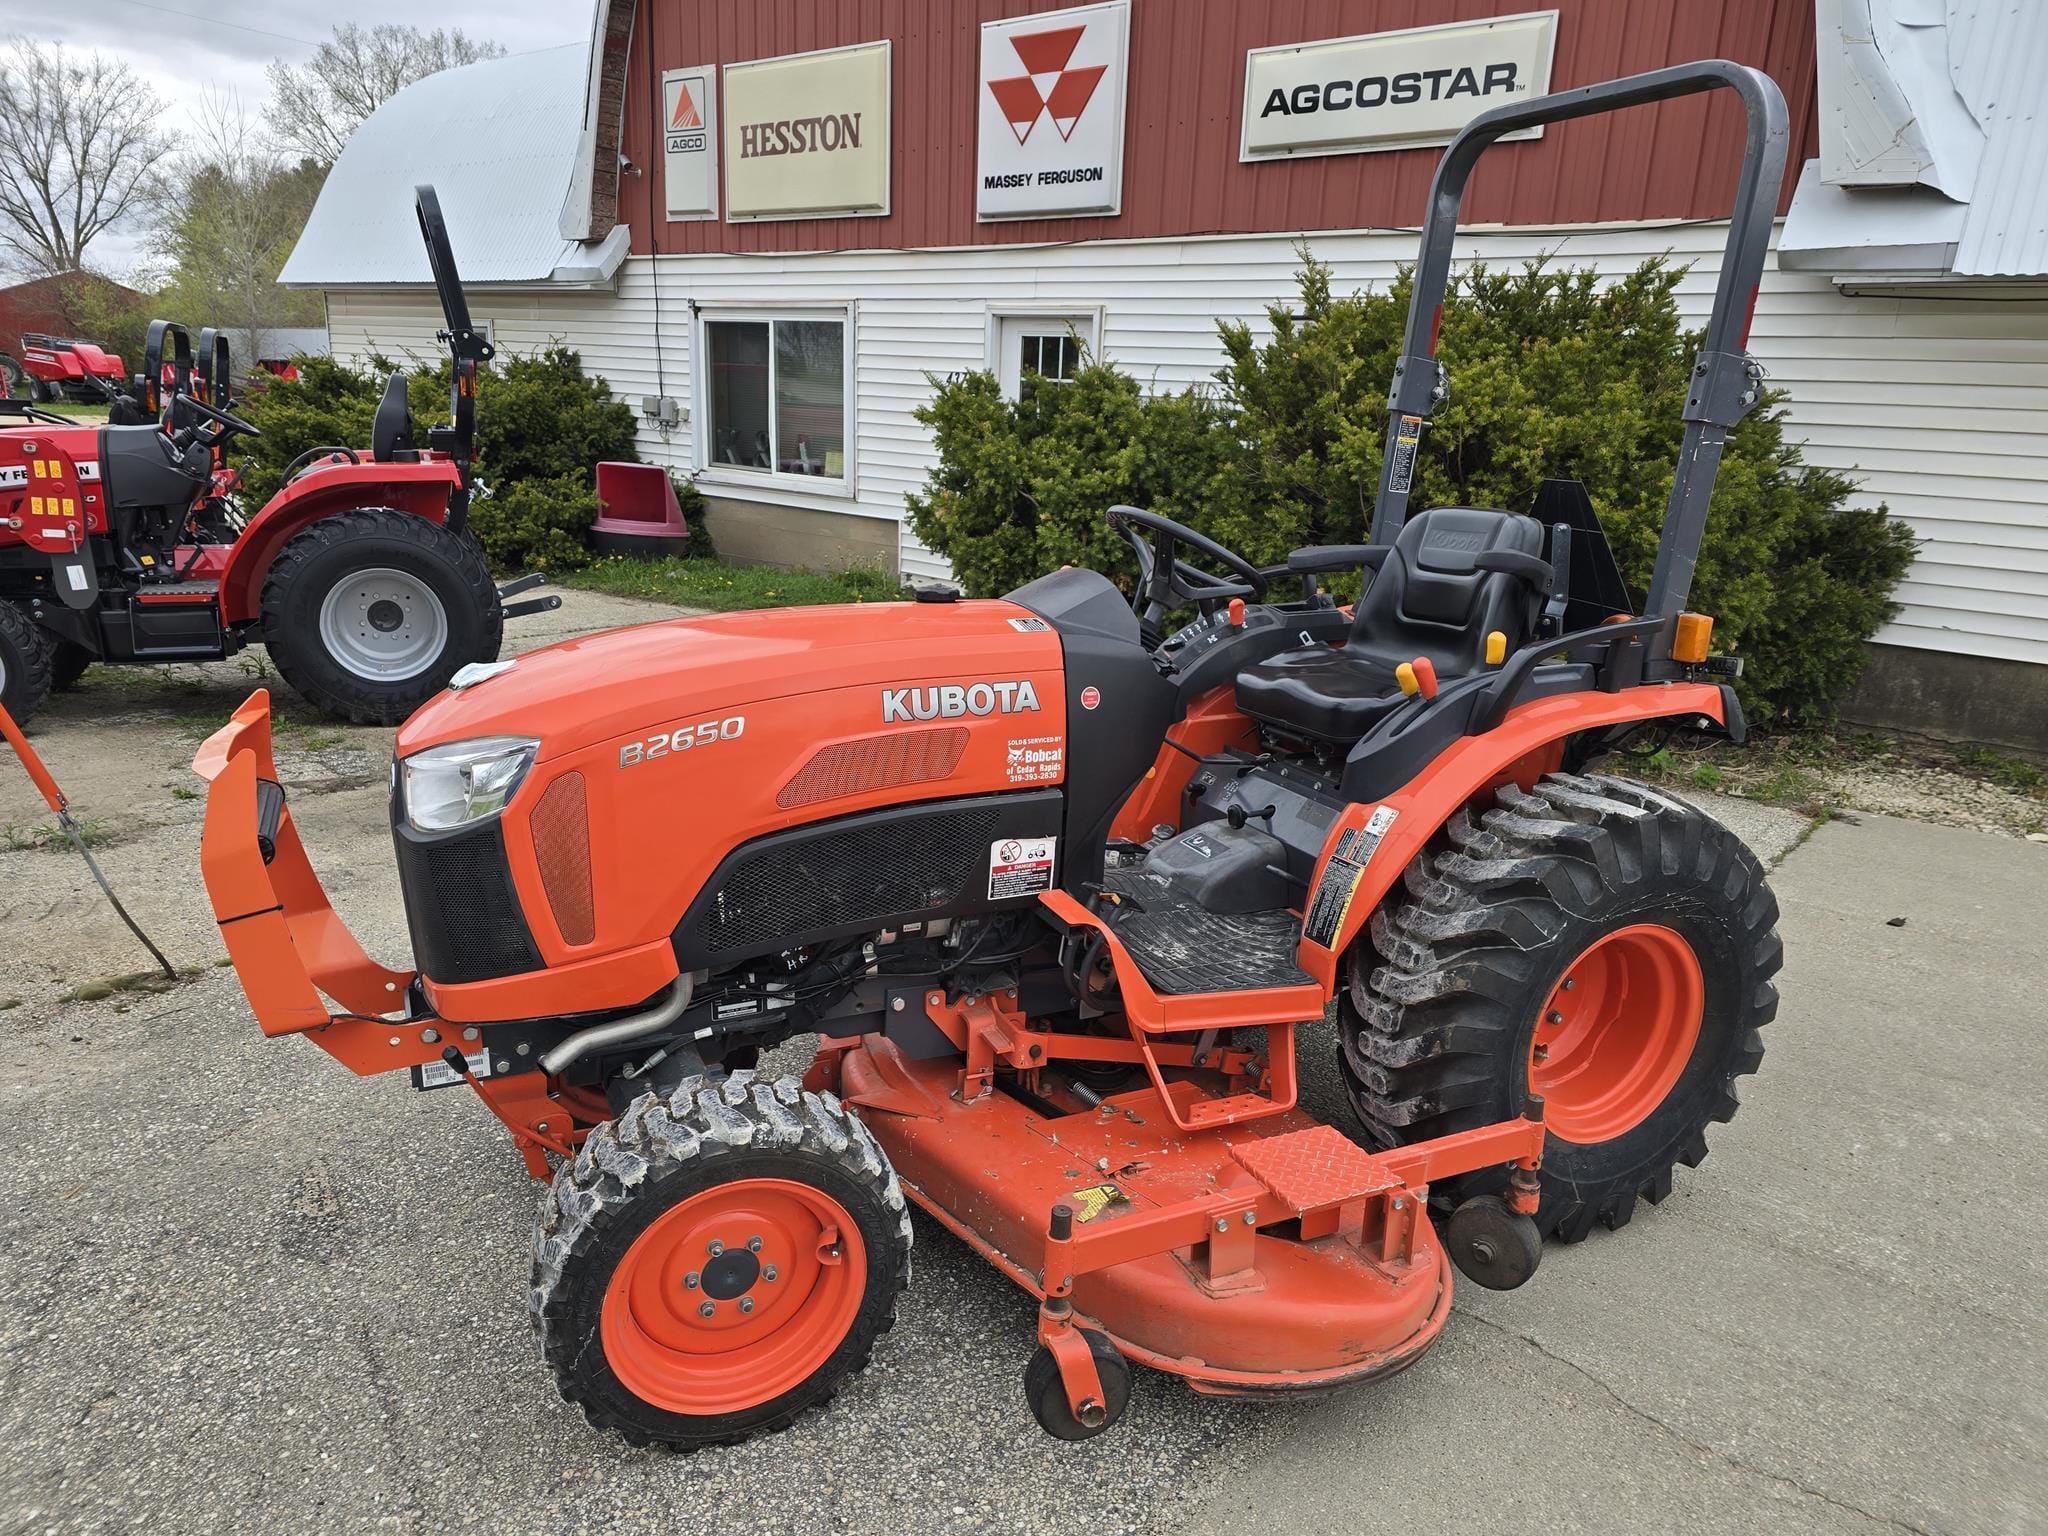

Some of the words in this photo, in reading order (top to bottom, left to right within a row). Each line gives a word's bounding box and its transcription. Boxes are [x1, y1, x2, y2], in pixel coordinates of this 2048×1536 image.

[1260, 62, 1517, 118] AGCOSTAR
[671, 137, 702, 150] AGCO
[740, 113, 861, 158] HESSTON
[984, 173, 1033, 190] MASSEY
[1038, 167, 1103, 186] FERGUSON
[882, 680, 1041, 723] KUBOTA
[619, 716, 746, 769] B2650
[1028, 736, 1054, 745] SERVICED
[1025, 748, 1062, 763] Bobcat
[1006, 767, 1015, 775] of
[1017, 765, 1036, 774] Cedar
[1040, 763, 1061, 773] Rapids
[1010, 771, 1057, 782] 319-393-2830
